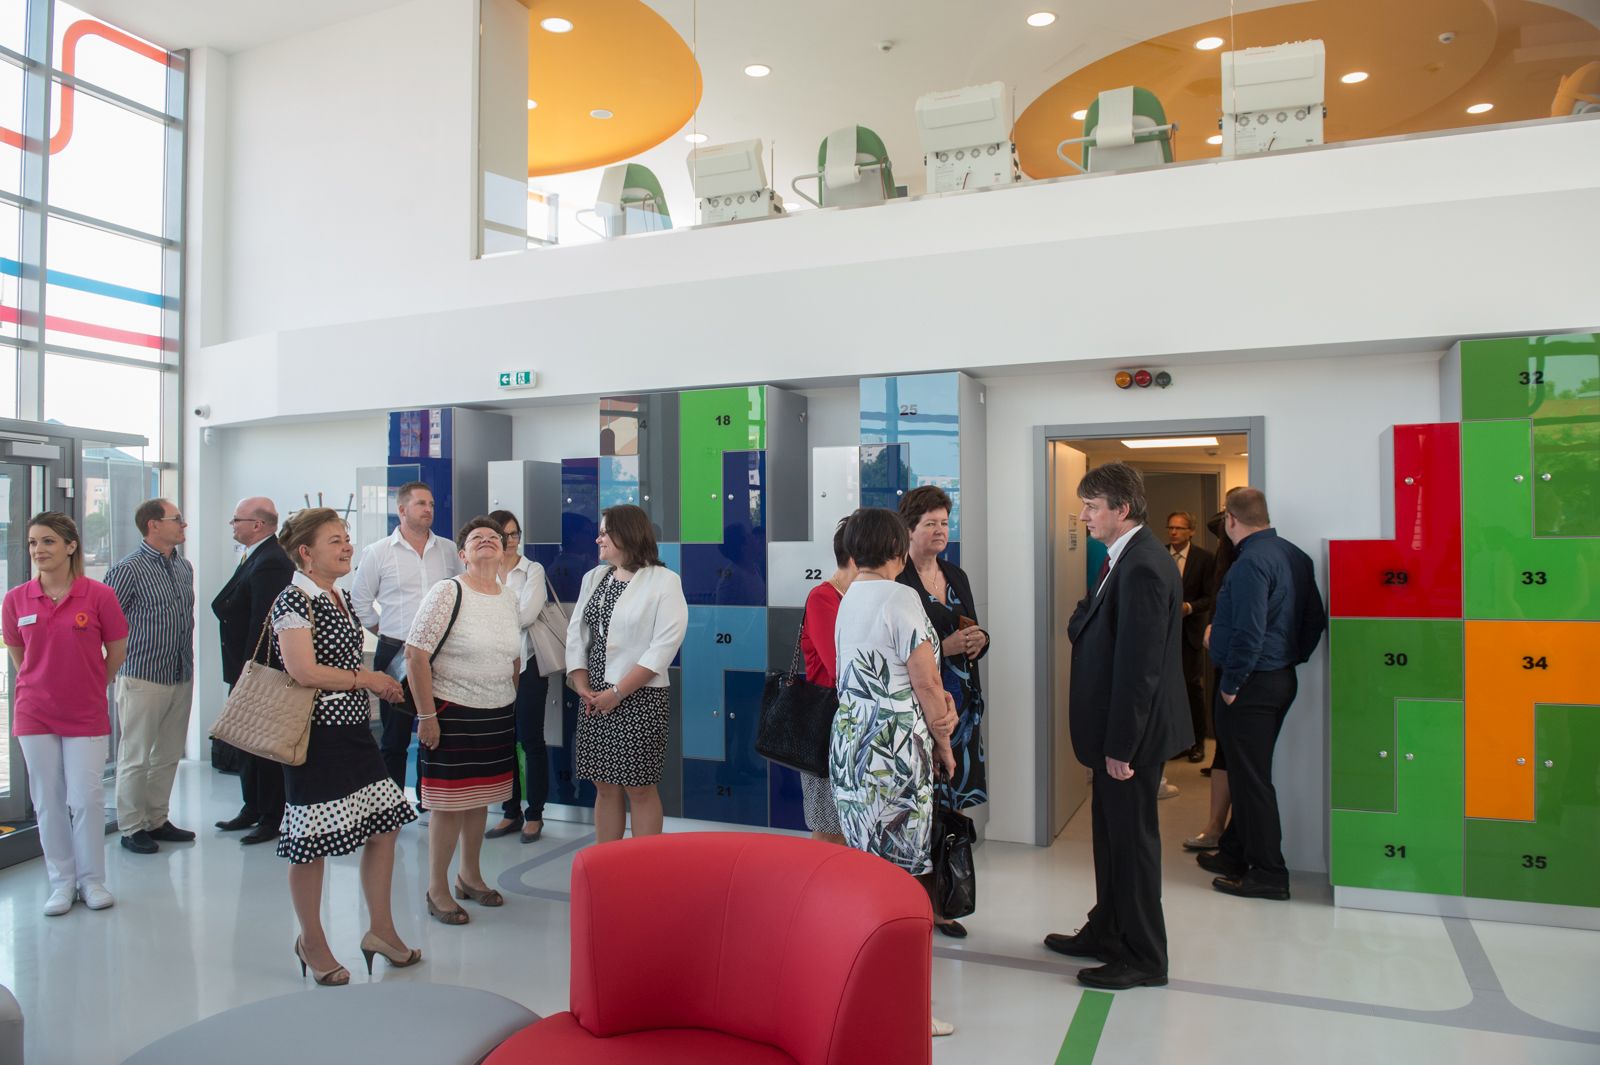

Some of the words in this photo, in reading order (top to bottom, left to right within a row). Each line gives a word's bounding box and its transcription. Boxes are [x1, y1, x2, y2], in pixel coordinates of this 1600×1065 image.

[1519, 371, 1544, 385] 32
[899, 404, 918, 416] 25
[715, 414, 731, 426] 18
[805, 568, 822, 580] 22
[1384, 571, 1408, 585] 29
[1521, 571, 1547, 585] 33
[716, 633, 732, 645] 20
[1384, 653, 1408, 666] 30
[1522, 656, 1548, 670] 34
[716, 785, 731, 797] 21
[1384, 845, 1406, 859] 31
[1522, 854, 1547, 869] 35
